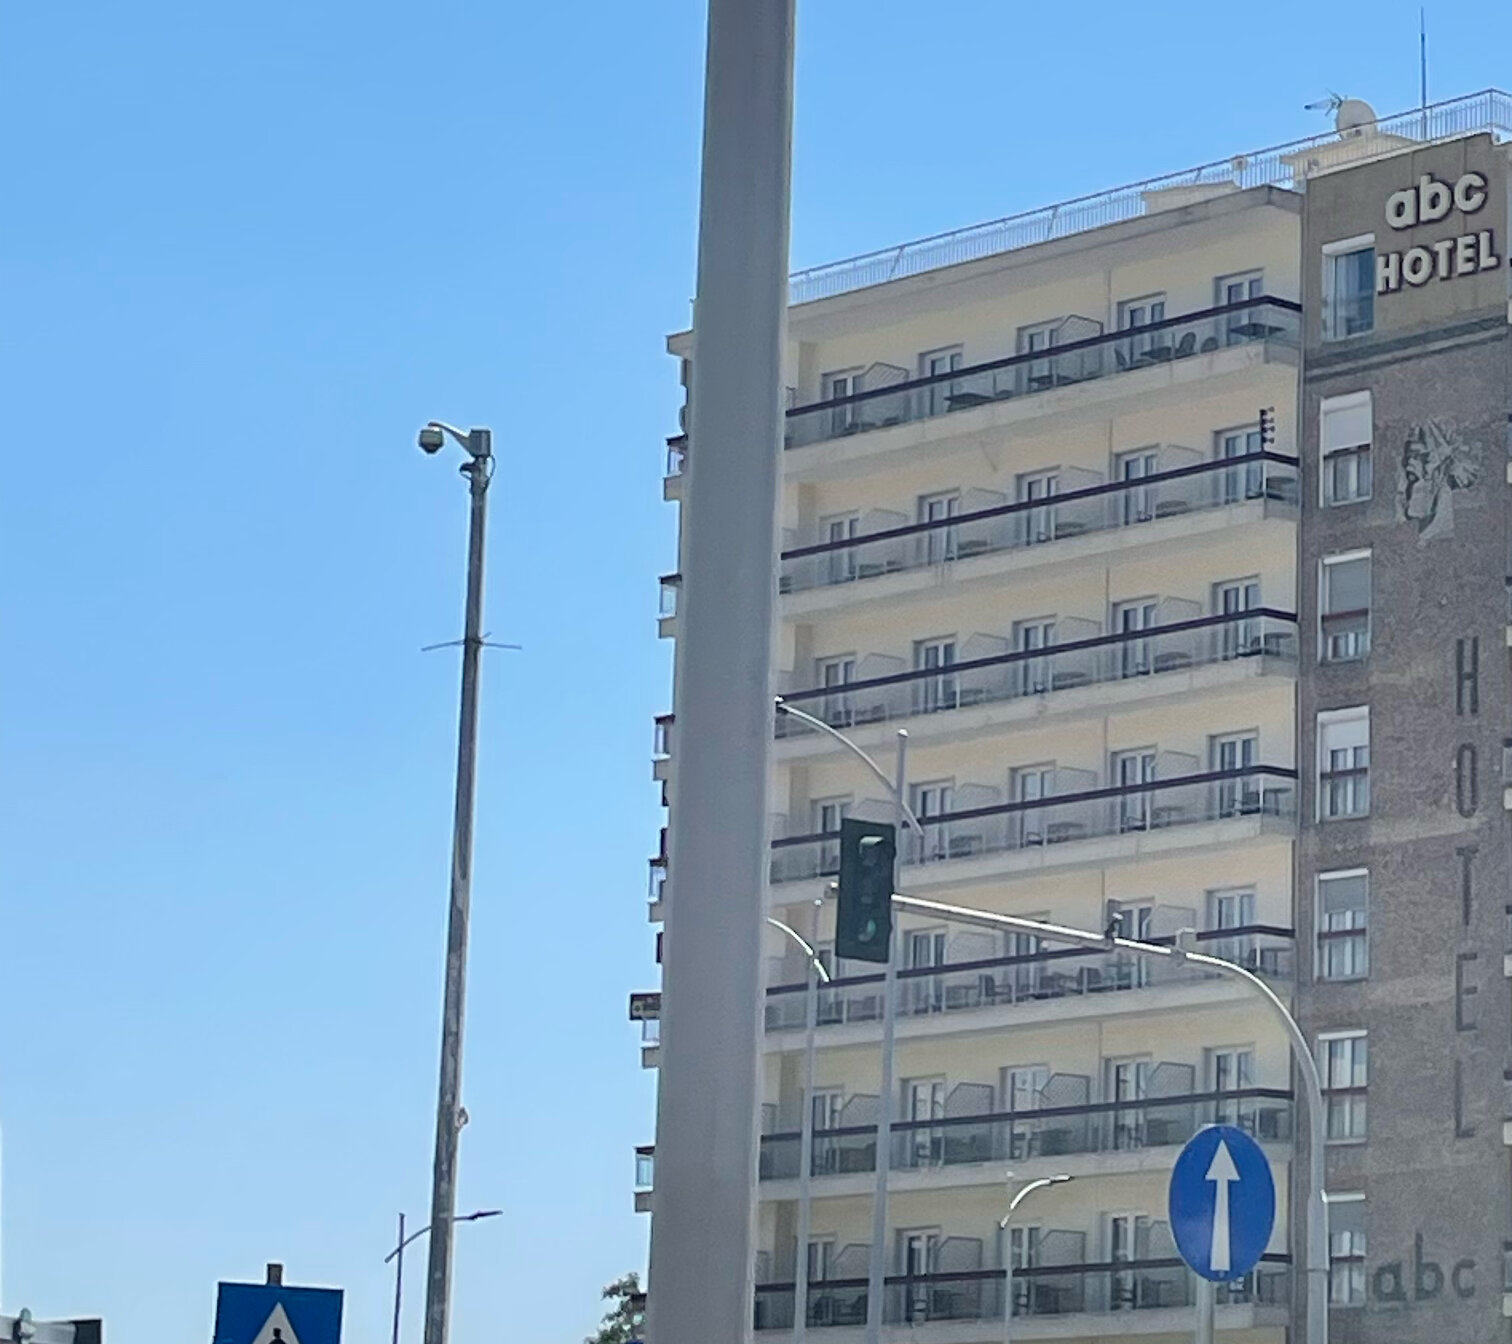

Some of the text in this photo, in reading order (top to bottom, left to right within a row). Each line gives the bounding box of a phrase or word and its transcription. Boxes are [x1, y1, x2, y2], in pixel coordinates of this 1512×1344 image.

[1385, 172, 1487, 230] abc
[1376, 229, 1499, 294] HOTEL
[1455, 636, 1479, 1139] HOTEL
[1372, 1233, 1477, 1303] abc
